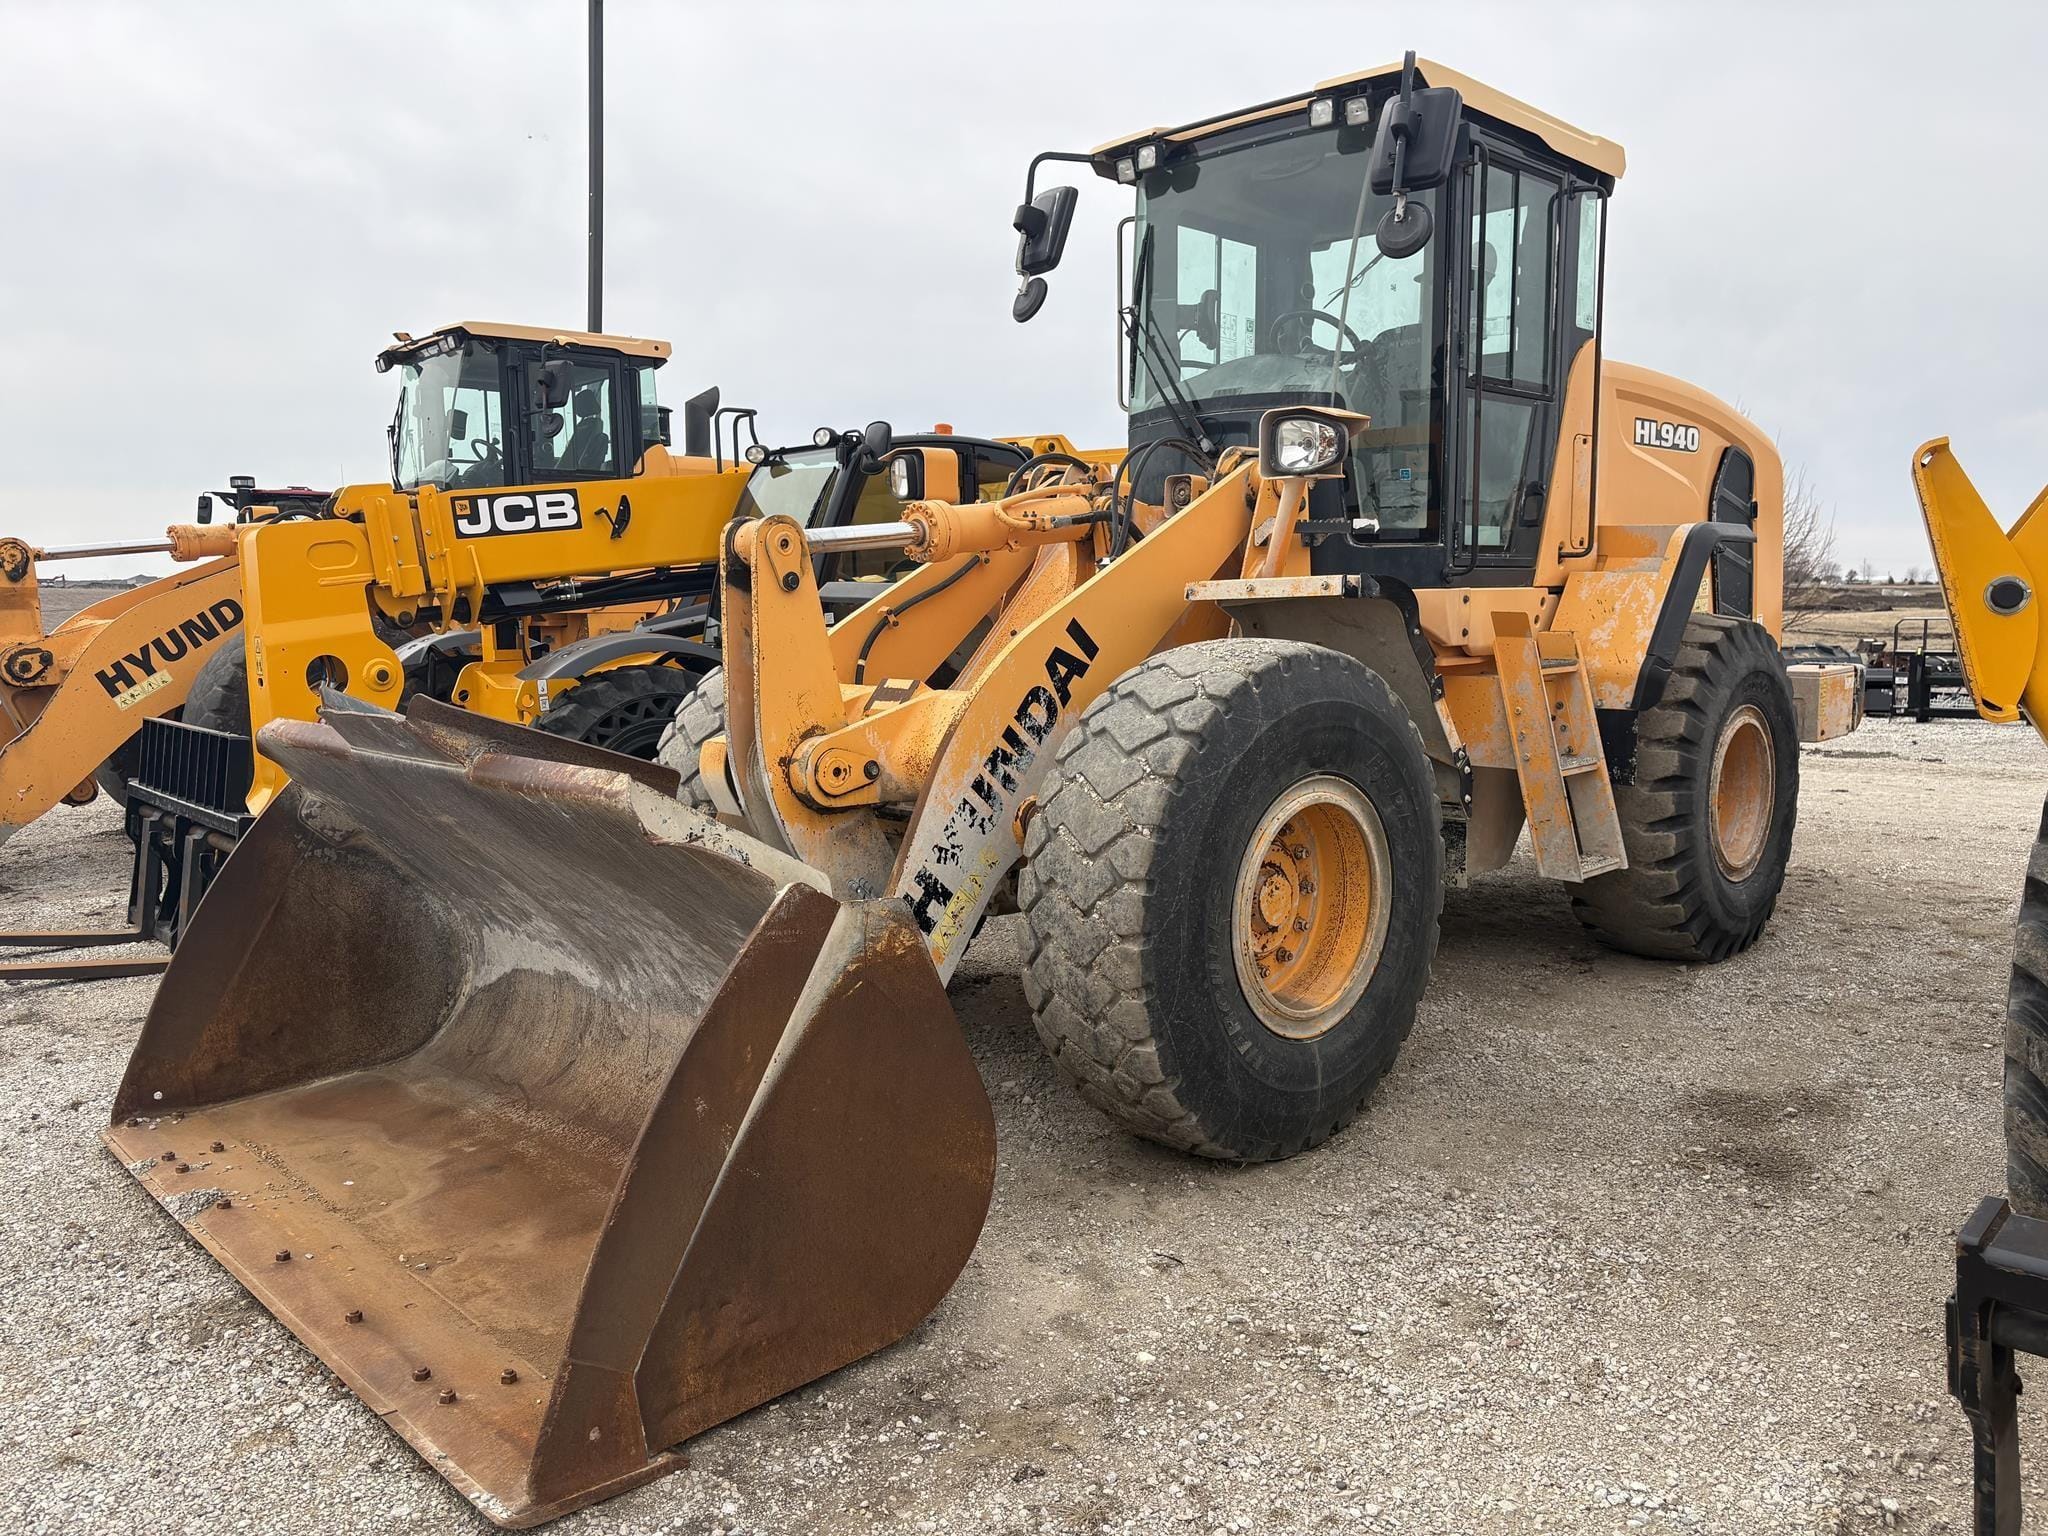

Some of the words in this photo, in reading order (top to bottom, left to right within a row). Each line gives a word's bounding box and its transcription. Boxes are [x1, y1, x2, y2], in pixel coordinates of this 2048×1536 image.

[1634, 417, 1700, 453] HL940
[457, 493, 579, 535] JCB
[94, 598, 244, 699] HYUND
